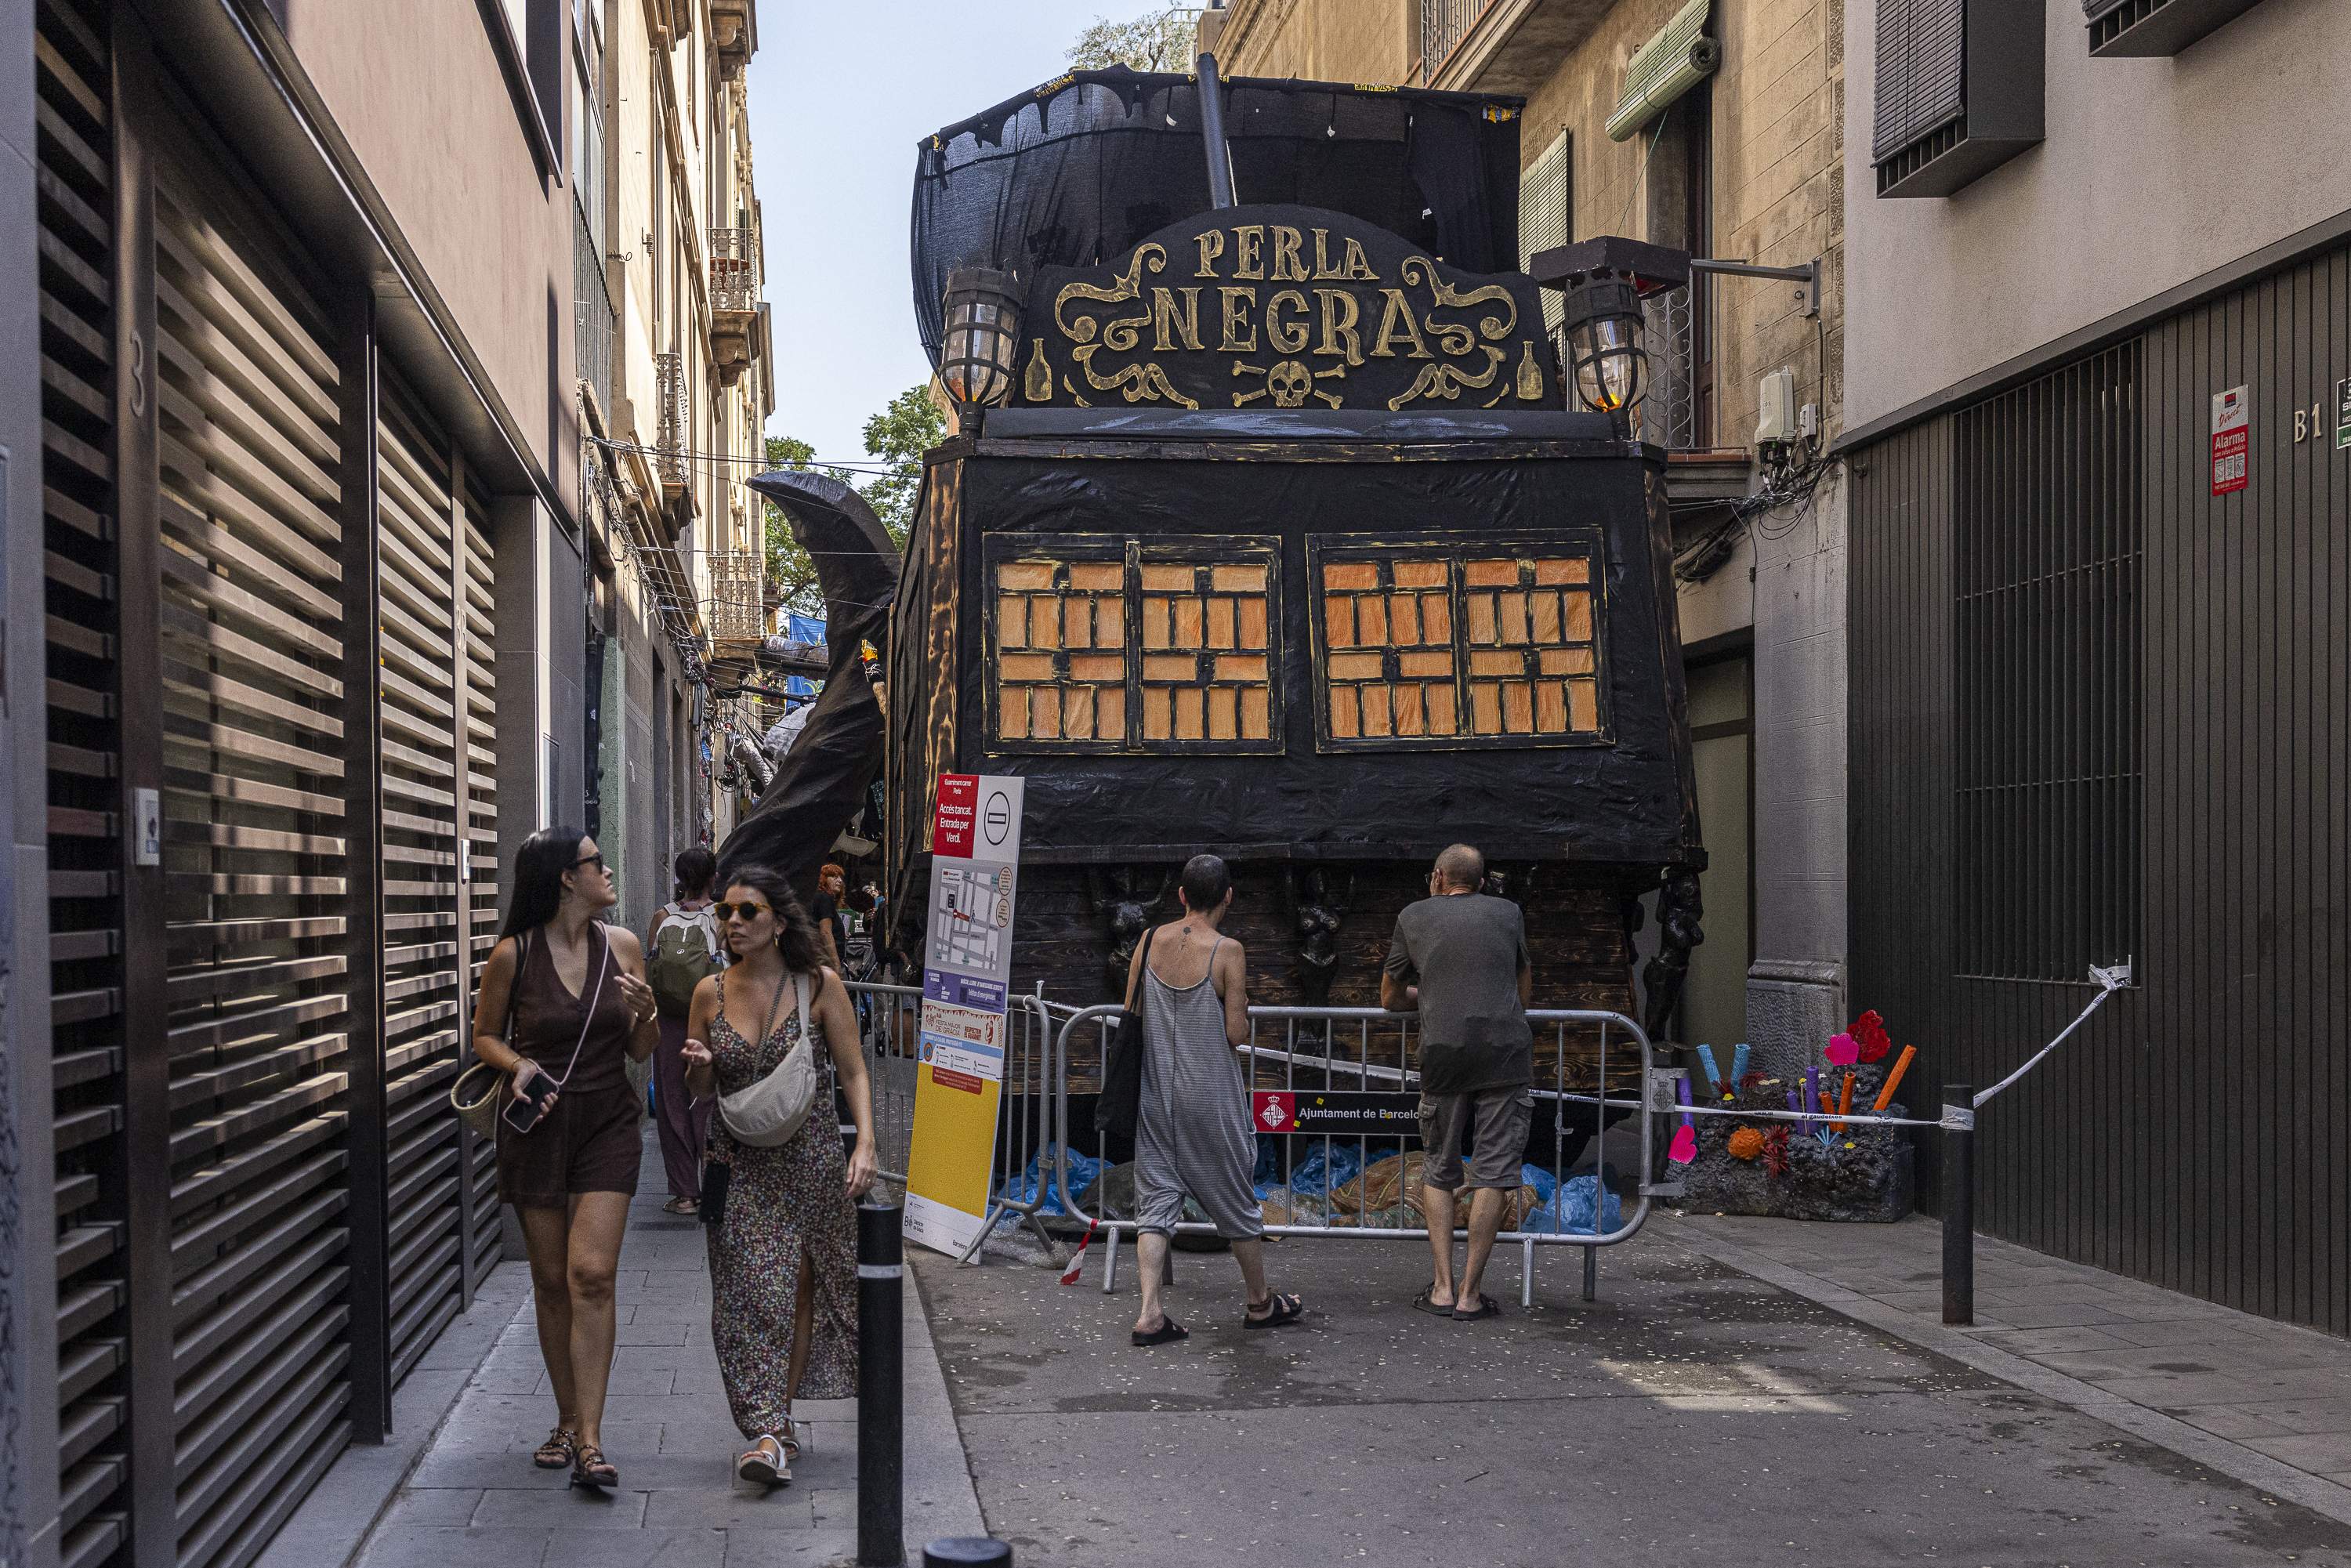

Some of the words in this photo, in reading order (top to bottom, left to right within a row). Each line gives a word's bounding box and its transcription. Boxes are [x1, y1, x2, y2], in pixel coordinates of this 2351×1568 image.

[1194, 225, 1380, 282] PERLA
[1151, 285, 1435, 368] NEGRA
[129, 331, 144, 418] 3
[2294, 403, 2322, 444] B1
[2215, 432, 2245, 451] Alarma
[939, 803, 955, 815] Accés
[955, 805, 973, 816] tancat.
[940, 817, 960, 829] Entrada
[960, 821, 969, 831] per
[946, 832, 961, 843] Verdi.
[1299, 1107, 1360, 1120] Ajuntament
[1362, 1108, 1376, 1119] de
[1379, 1109, 1419, 1120] Barcelo
[904, 1215, 909, 1227] B
